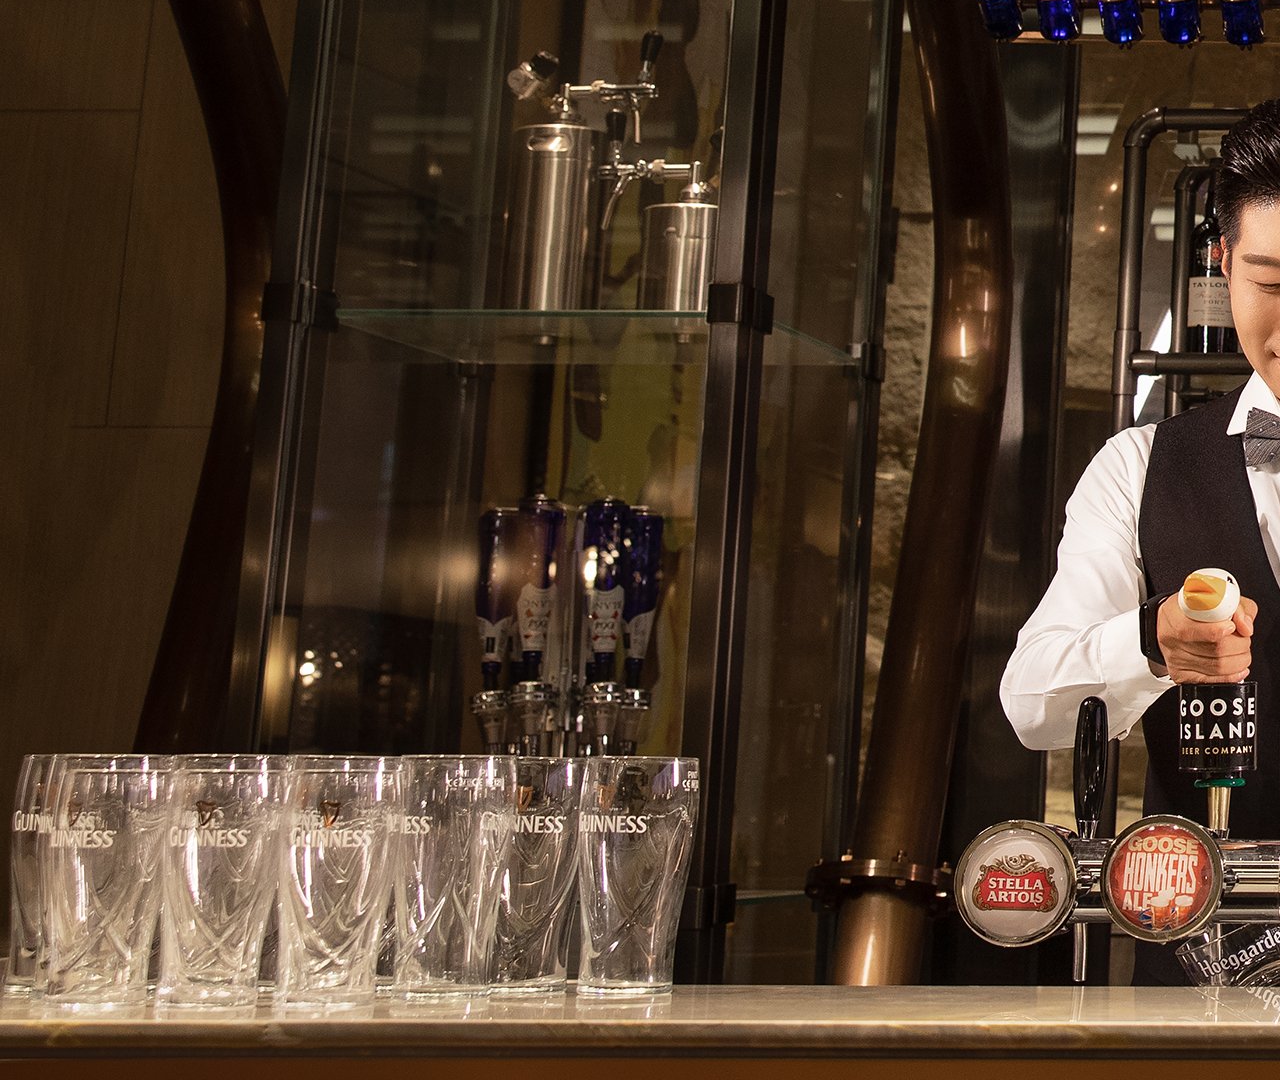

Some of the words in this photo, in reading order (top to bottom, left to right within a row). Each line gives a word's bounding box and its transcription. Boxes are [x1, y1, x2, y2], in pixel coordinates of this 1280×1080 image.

[1180, 697, 1255, 717] GOOSE
[1180, 721, 1256, 740] ISLAND
[1204, 745, 1253, 755] COMPANY
[1127, 836, 1199, 855] GOOSE
[1122, 852, 1199, 894] HONKERS
[988, 877, 1044, 890] STELLA
[986, 891, 1044, 905] ARTOIS
[1122, 892, 1152, 911] ALE
